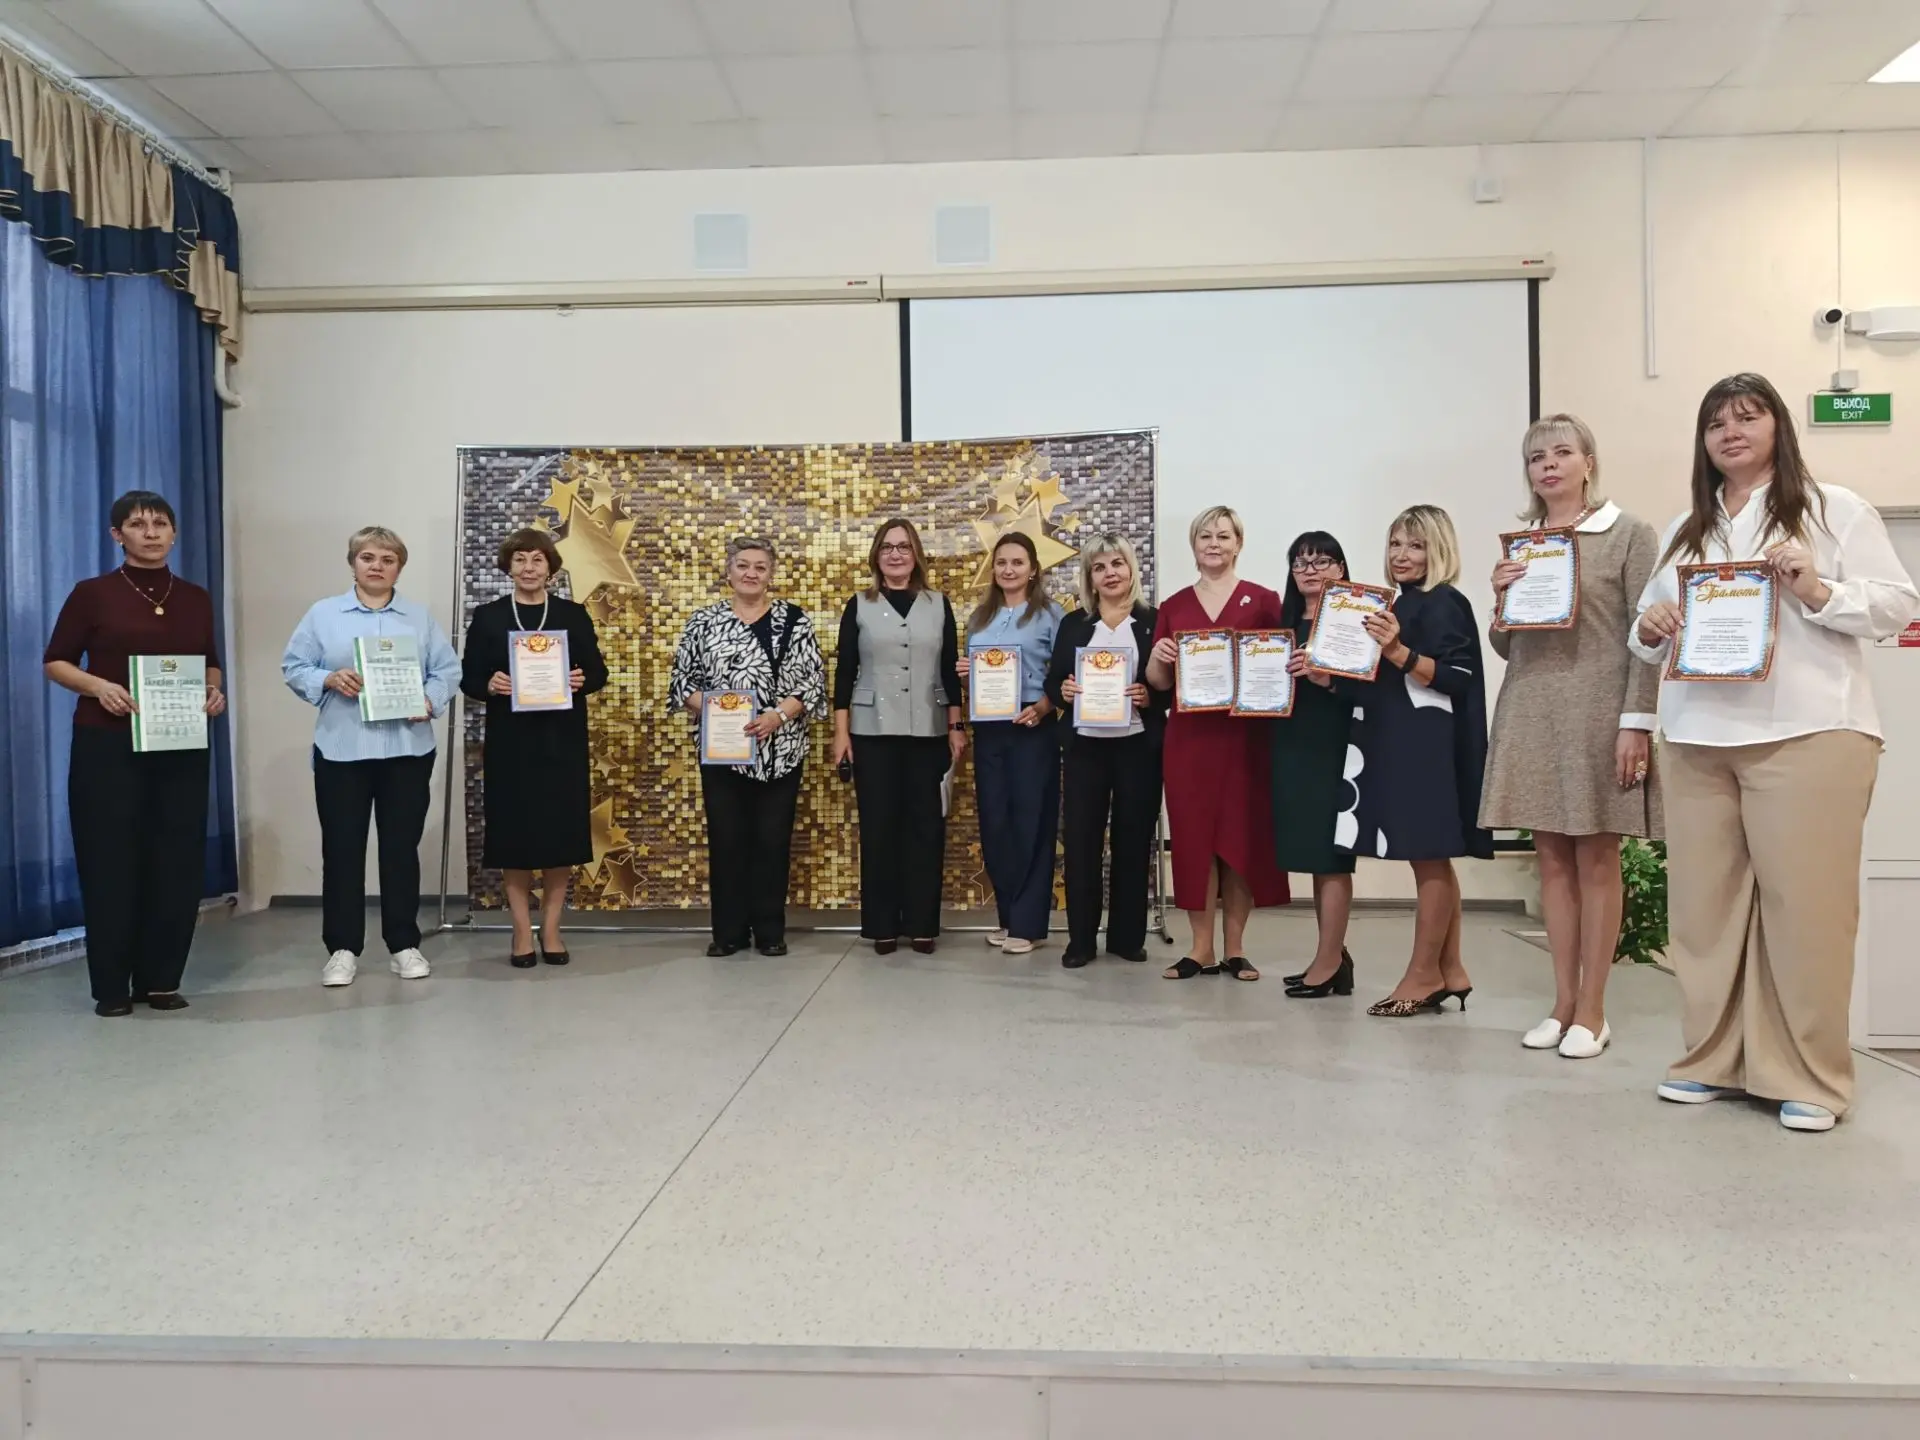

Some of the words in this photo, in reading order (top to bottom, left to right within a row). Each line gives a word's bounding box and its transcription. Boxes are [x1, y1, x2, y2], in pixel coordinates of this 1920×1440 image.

[1833, 397, 1870, 410] ВЫХОД
[1841, 411, 1863, 419] EXIT
[1695, 582, 1760, 604] Грамота
